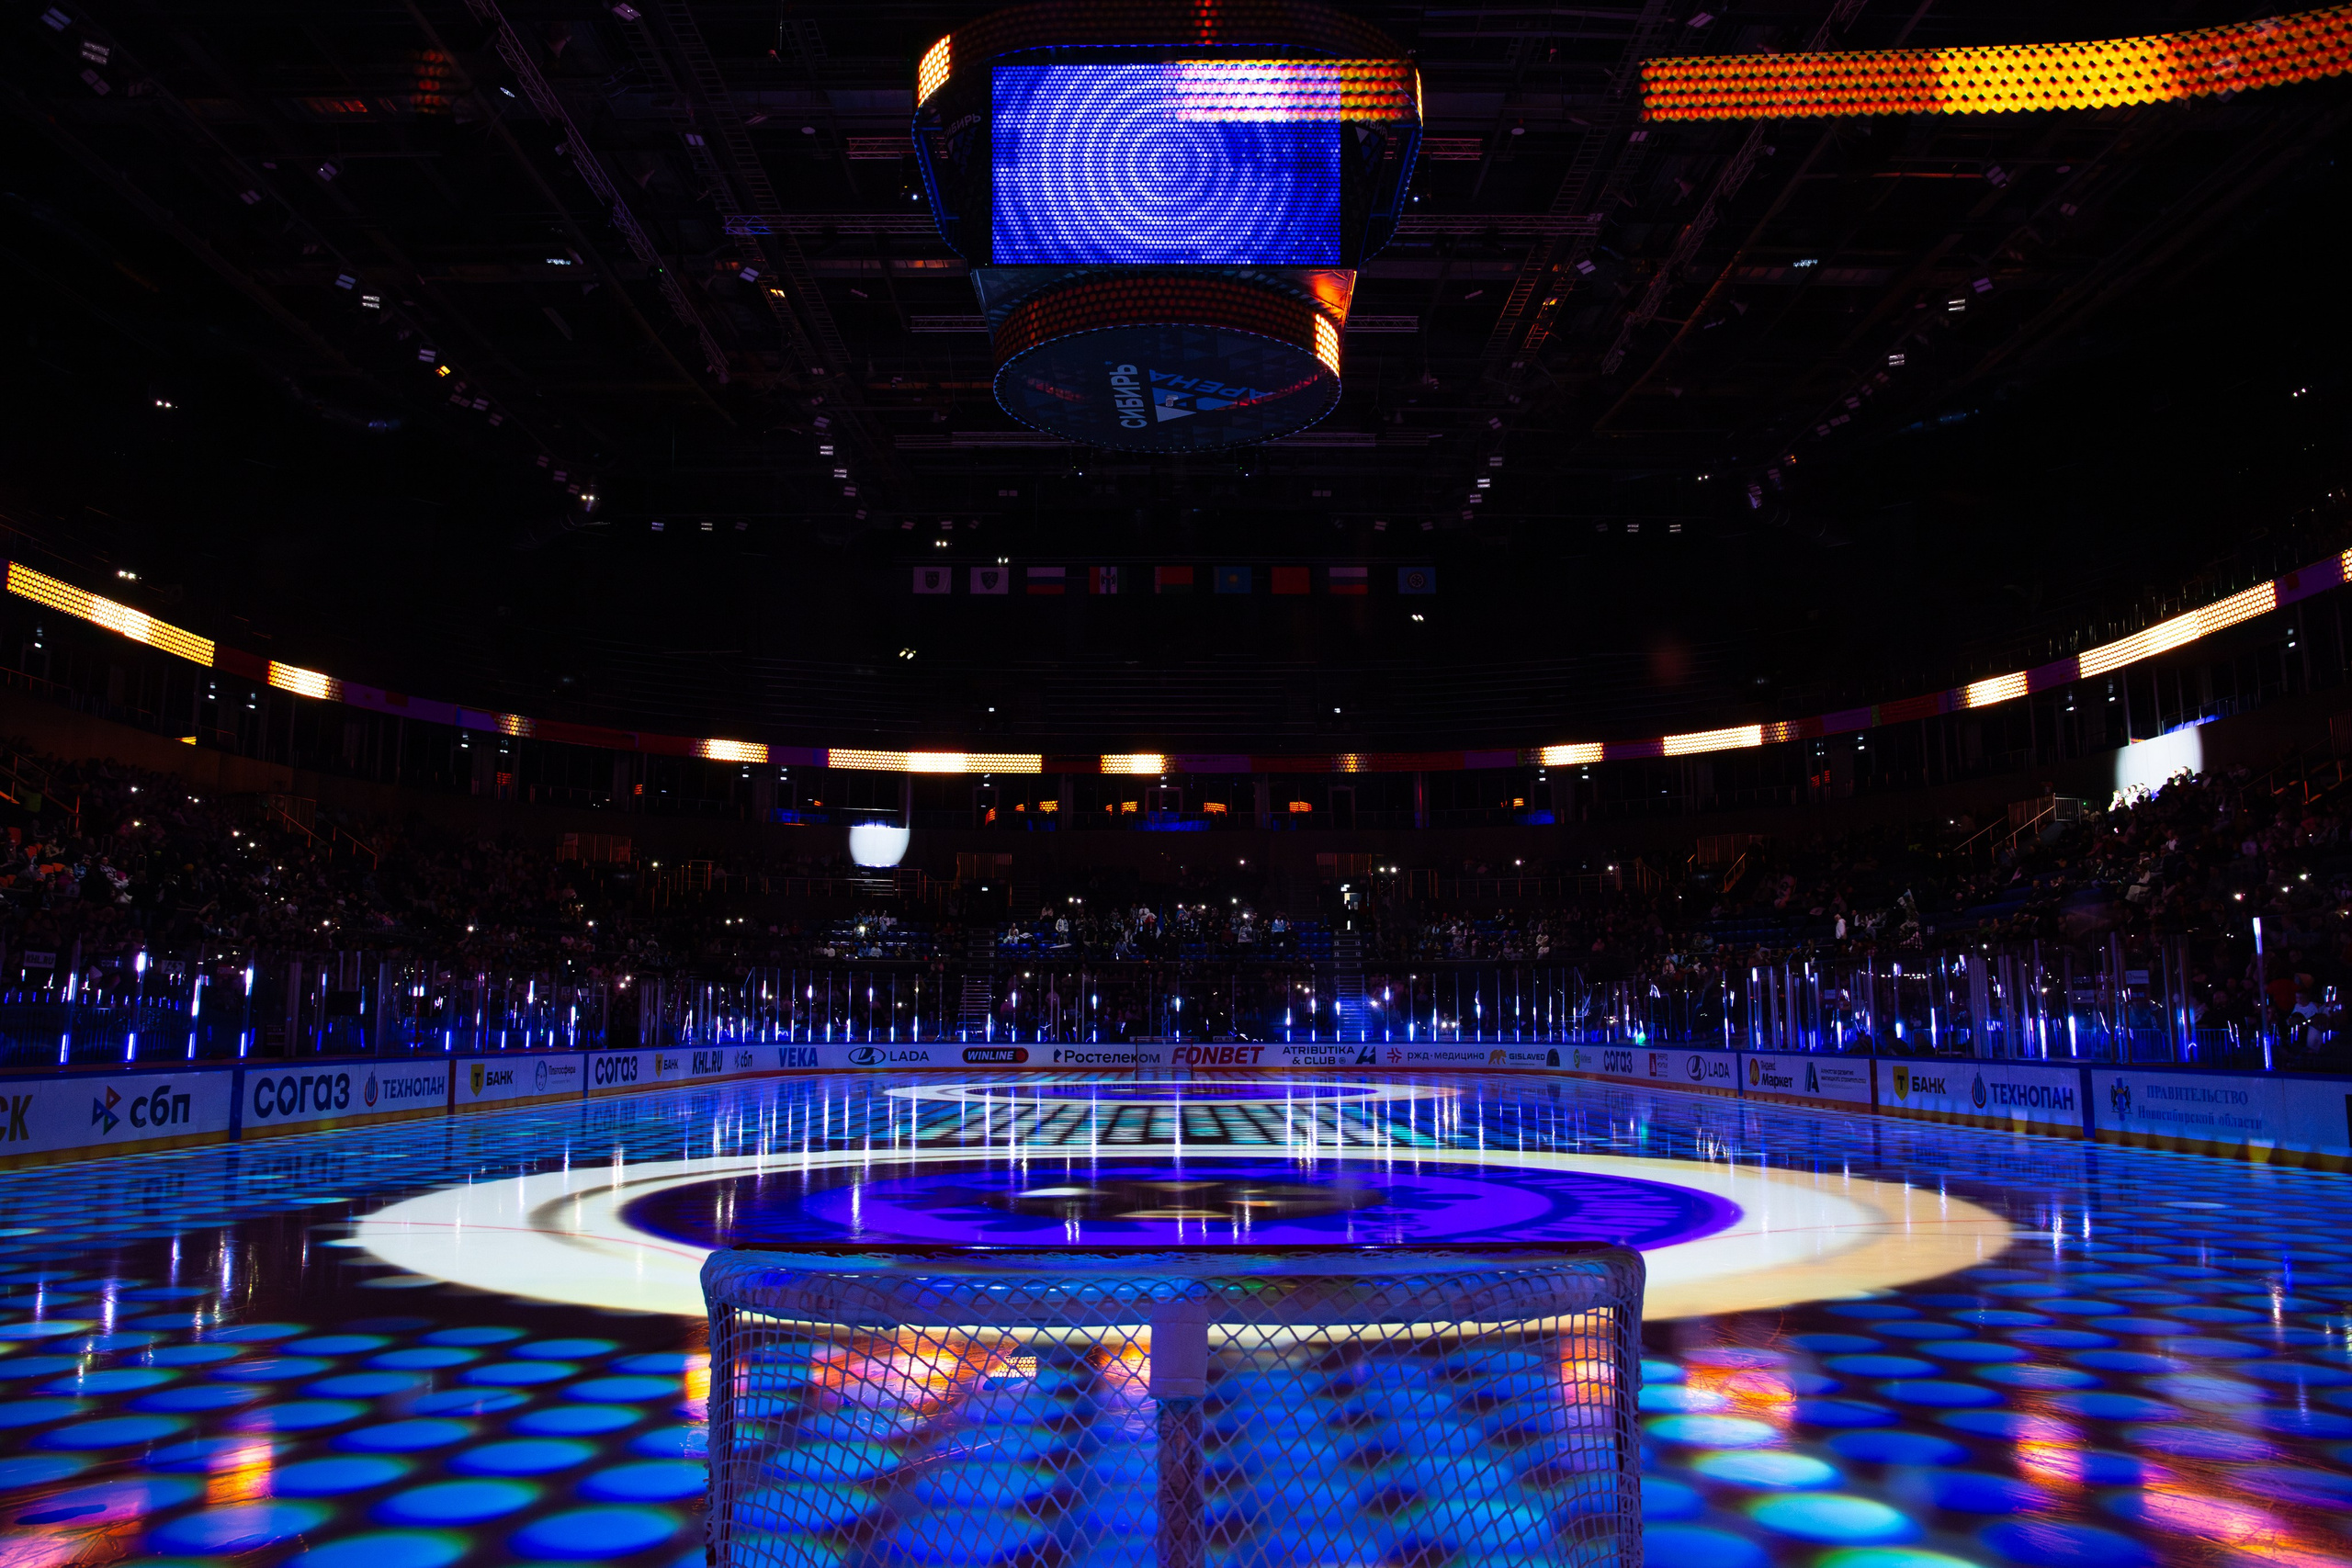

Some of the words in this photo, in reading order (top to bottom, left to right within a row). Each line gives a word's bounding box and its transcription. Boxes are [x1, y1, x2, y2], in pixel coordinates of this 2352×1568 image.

[1148, 368, 1276, 400] АРЕНА
[1108, 364, 1148, 429] СИБИРЬ
[778, 1047, 819, 1067] VEKA
[889, 1051, 930, 1062] LADA
[967, 1050, 1014, 1061] WINLINE
[1065, 1050, 1160, 1063] Ростелеком
[1171, 1046, 1265, 1065] FONBET
[1283, 1046, 1355, 1055] ATRIBUTIKA
[1510, 1053, 1545, 1061] GISLAVED
[664, 1058, 679, 1070] БАНК
[692, 1051, 723, 1075] KHL.RU
[1304, 1056, 1336, 1065] CLUB
[487, 1070, 514, 1086] БАНК
[1708, 1062, 1730, 1078] LADA
[383, 1077, 445, 1099] ТЕХНОПАН
[1761, 1073, 1793, 1089] Маркет
[1912, 1076, 1946, 1094] БАНК
[1990, 1083, 2074, 1111] ТЕХНОПАН
[2147, 1085, 2248, 1105] ПРАВИТЕЛЬСТВО
[2138, 1105, 2214, 1125] Новосибирской
[2219, 1114, 2263, 1130] области
